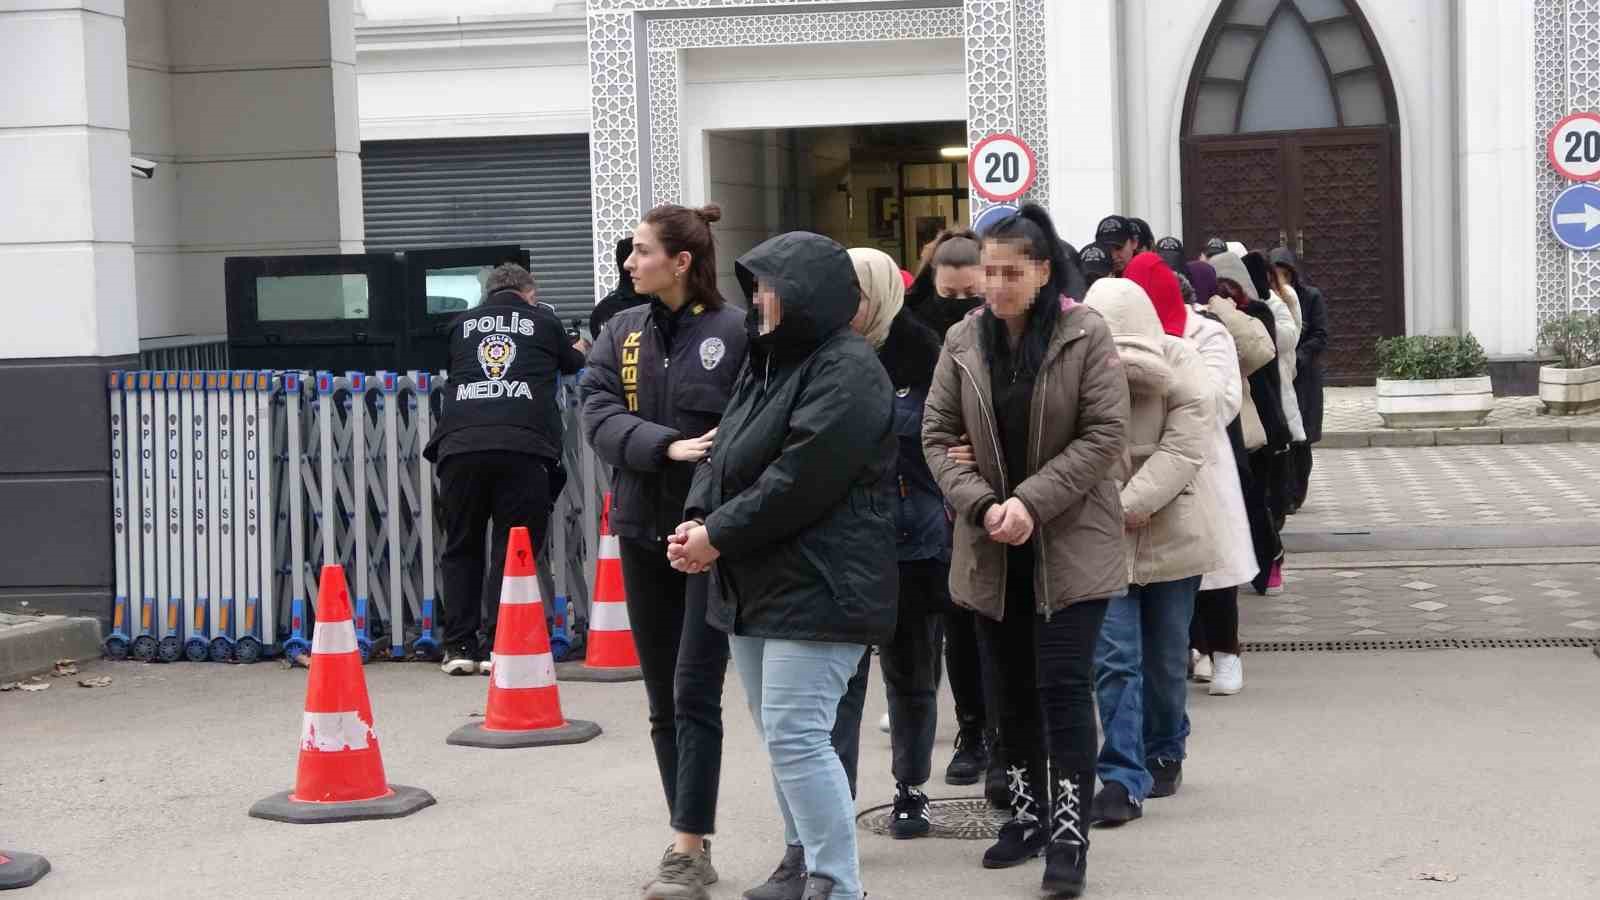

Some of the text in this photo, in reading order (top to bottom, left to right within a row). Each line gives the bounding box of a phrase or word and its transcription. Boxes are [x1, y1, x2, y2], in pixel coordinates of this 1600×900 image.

[1565, 130, 1600, 163] 20
[985, 151, 1019, 183] 20
[463, 311, 535, 338] POLİS
[456, 380, 533, 401] MEDYA
